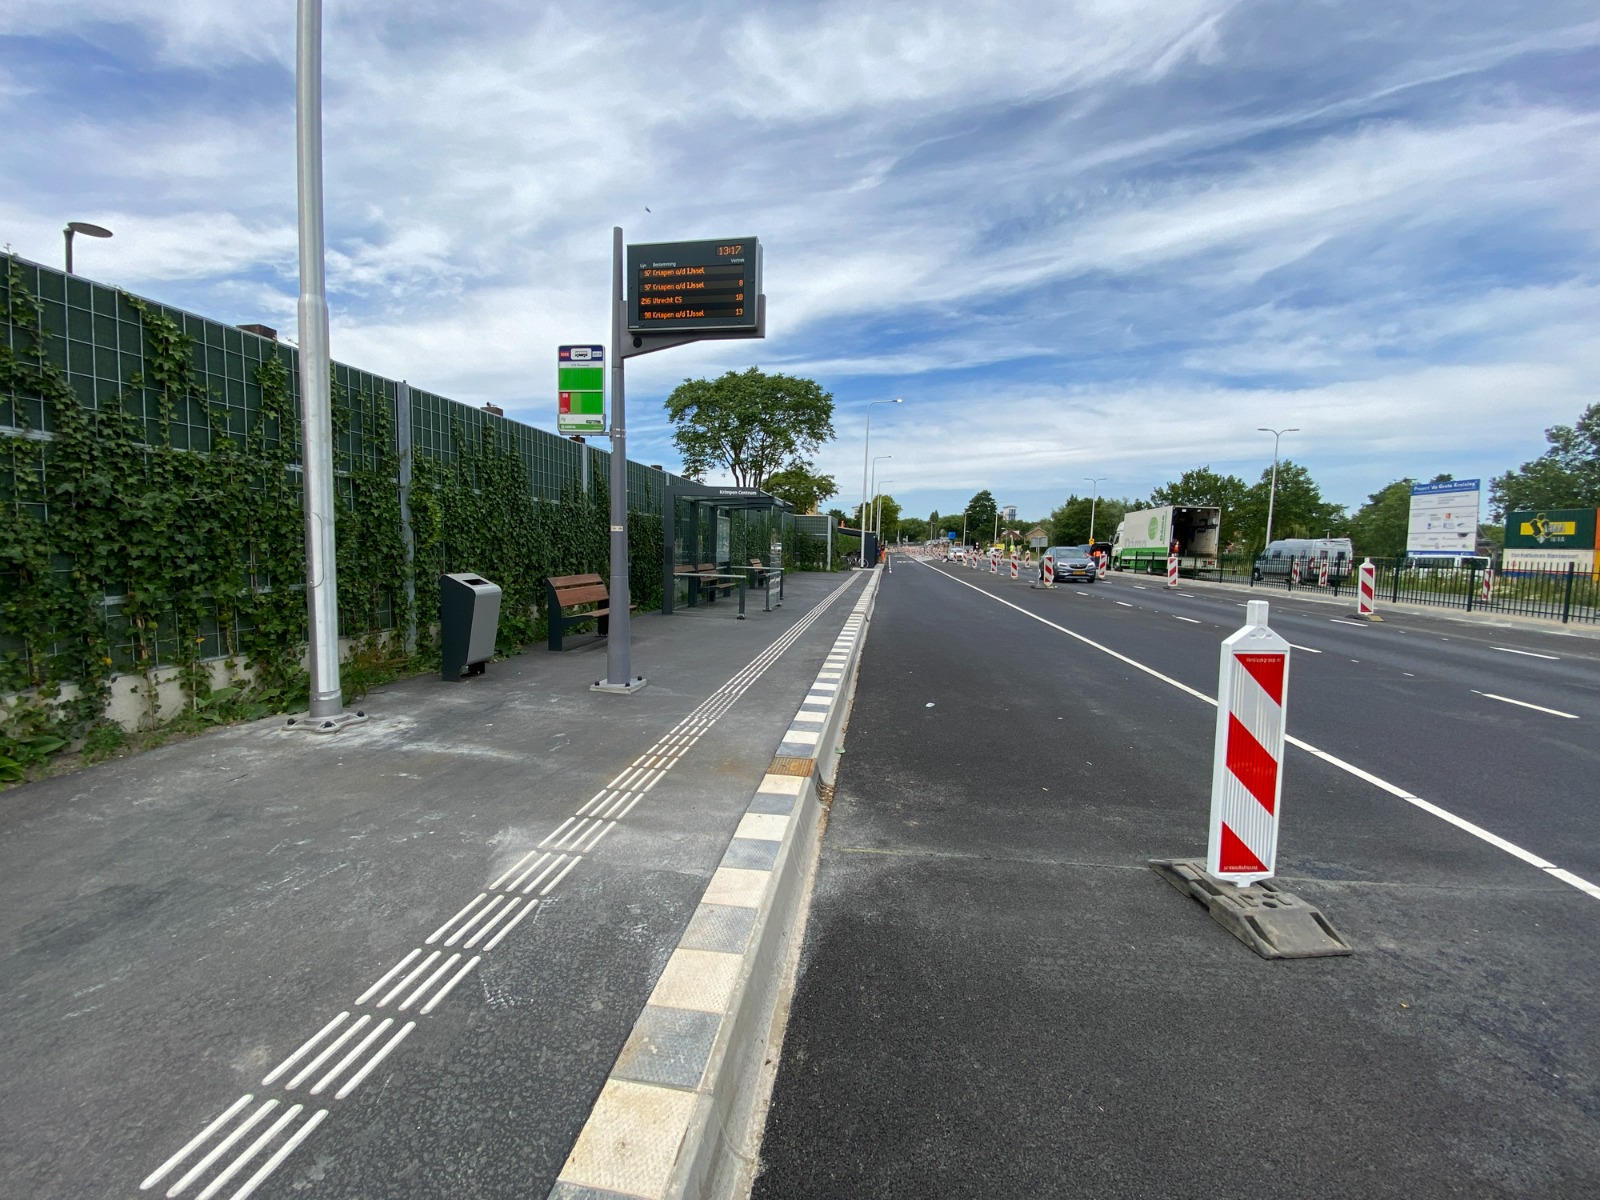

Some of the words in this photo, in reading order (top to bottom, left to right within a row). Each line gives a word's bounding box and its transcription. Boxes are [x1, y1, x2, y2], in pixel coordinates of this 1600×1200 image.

[718, 245, 742, 256] 13:17
[652, 269, 674, 277] Krimpen
[686, 267, 705, 275] IJssel
[652, 283, 674, 292] Krimpen
[652, 312, 674, 320] Krimpen
